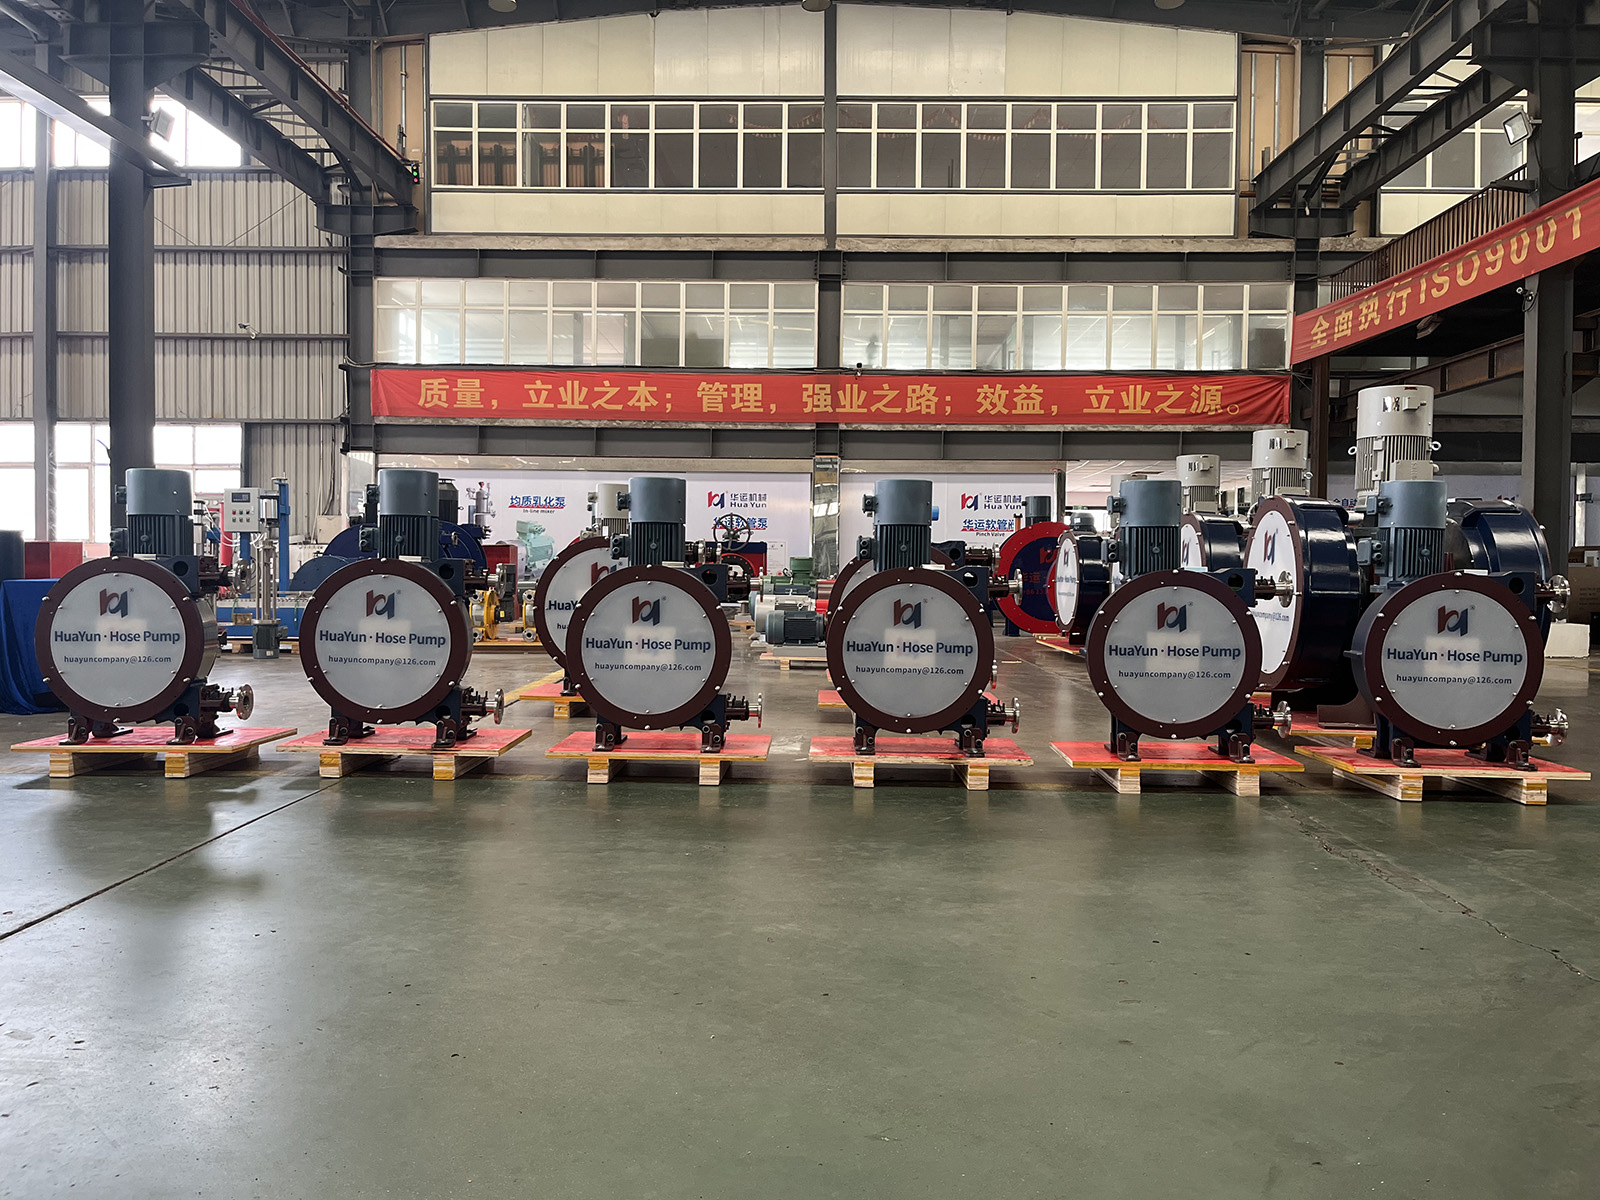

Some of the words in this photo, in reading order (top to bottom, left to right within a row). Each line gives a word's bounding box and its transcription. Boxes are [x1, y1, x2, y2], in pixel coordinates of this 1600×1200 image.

[510, 495, 566, 507] 均质乳化泵
[548, 600, 578, 611] HuaY
[54, 631, 102, 643] HuaYun
[109, 631, 140, 643] Hose
[143, 631, 180, 644] Pump
[319, 630, 367, 642] HuaYun
[375, 631, 406, 645] Hose
[408, 633, 447, 648] Pump
[585, 637, 633, 649] HuaYun
[641, 639, 672, 650] Hose
[674, 639, 711, 653] Pump
[846, 640, 894, 652] HuaYun
[902, 642, 933, 654] Hose
[936, 642, 974, 657] Pump
[1108, 645, 1158, 657] HuaYun
[1166, 645, 1199, 658] Hose
[1202, 646, 1242, 661] Pump
[1386, 648, 1438, 661] HuaYun
[1447, 650, 1480, 663] Hose
[1483, 651, 1523, 666] Pump
[64, 656, 171, 665] huayuncompany@126.com
[328, 655, 436, 666] huayuncompany@126.com
[594, 662, 702, 672] huayuncompany@126.com
[855, 665, 964, 676] huayuncompany@126.com
[1118, 669, 1231, 680] huayuncompany@126.com
[1396, 673, 1512, 685] huayuncompany@126.com
